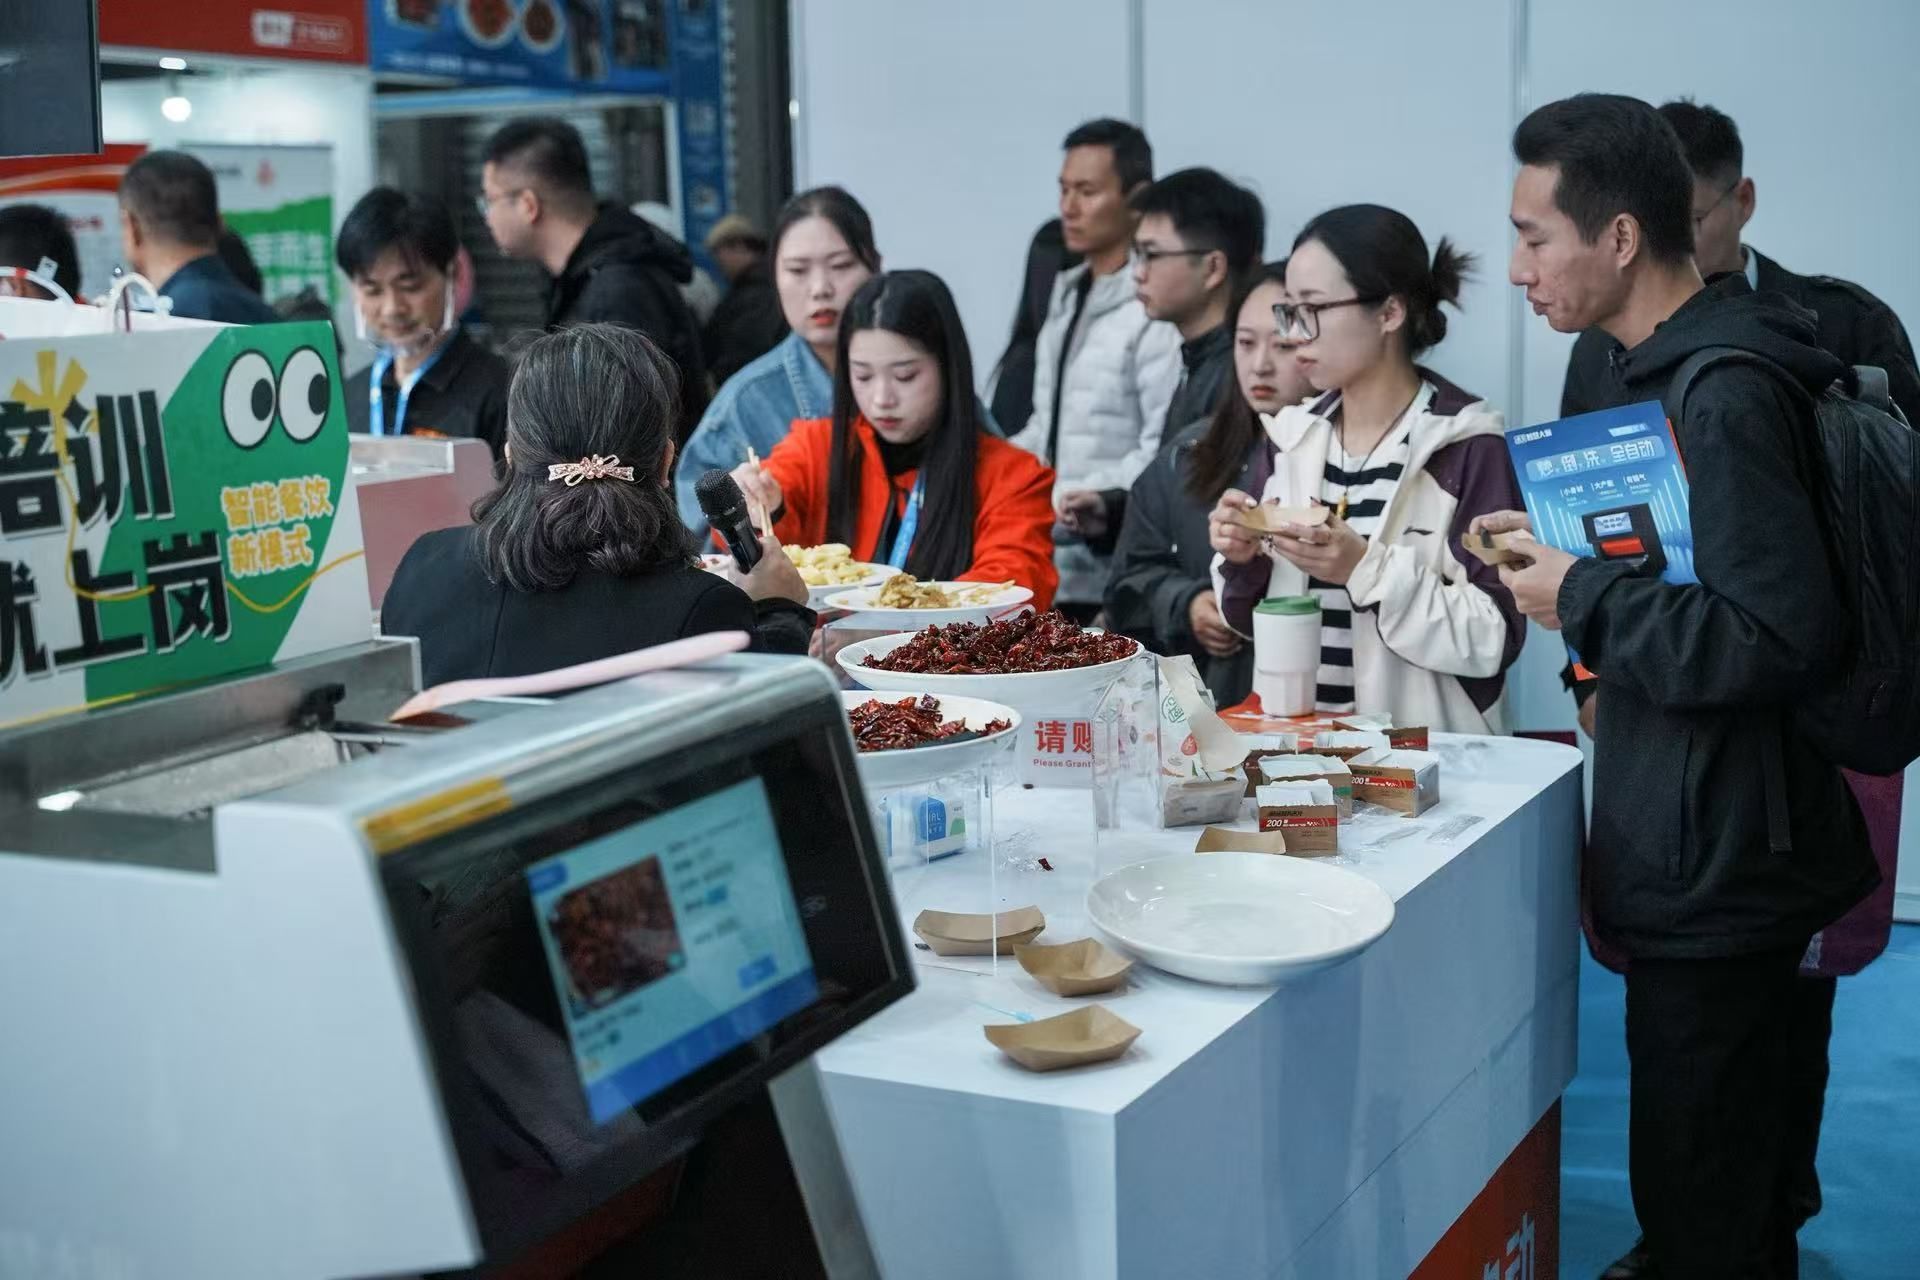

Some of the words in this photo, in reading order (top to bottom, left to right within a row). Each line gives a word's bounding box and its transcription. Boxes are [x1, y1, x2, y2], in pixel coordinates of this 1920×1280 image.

[221, 474, 334, 532] 智能餐饮
[226, 522, 315, 578] 新模式
[1033, 759, 1063, 768] Please
[1065, 760, 1091, 768] Grant
[1266, 819, 1282, 827] 200
